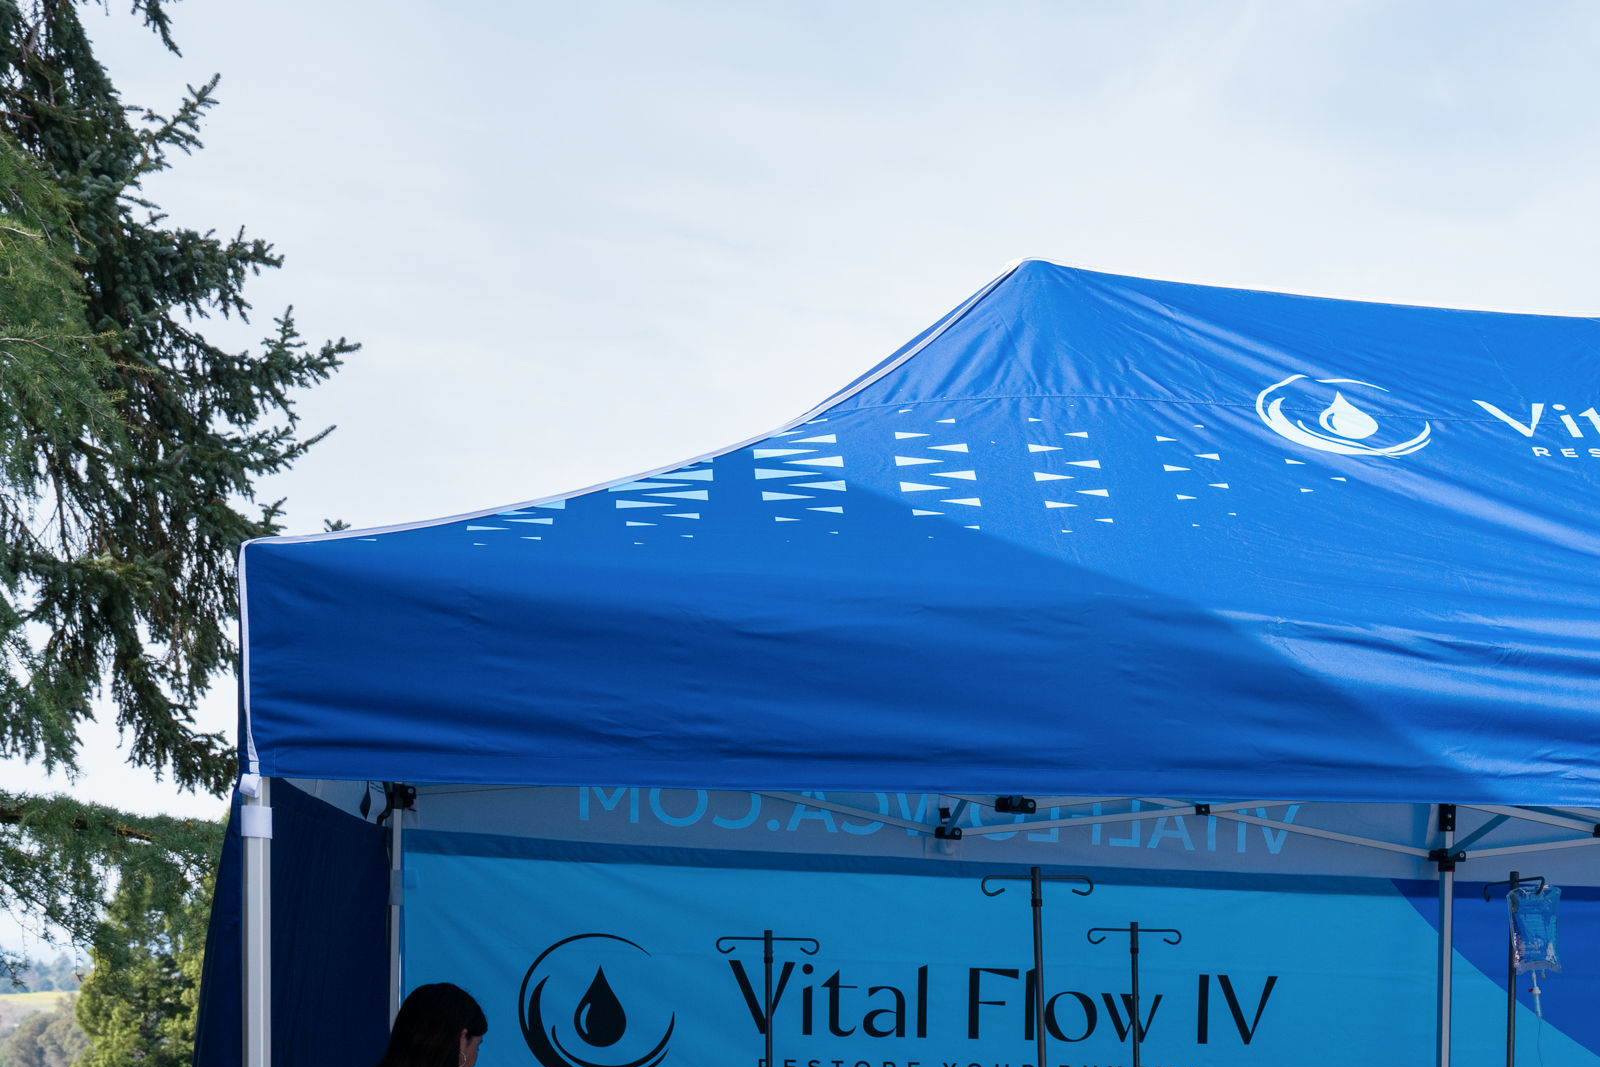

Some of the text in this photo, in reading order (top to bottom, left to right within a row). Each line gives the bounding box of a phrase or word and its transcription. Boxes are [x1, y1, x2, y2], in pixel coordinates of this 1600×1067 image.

[728, 959, 1278, 1045] Vital Flow IV
